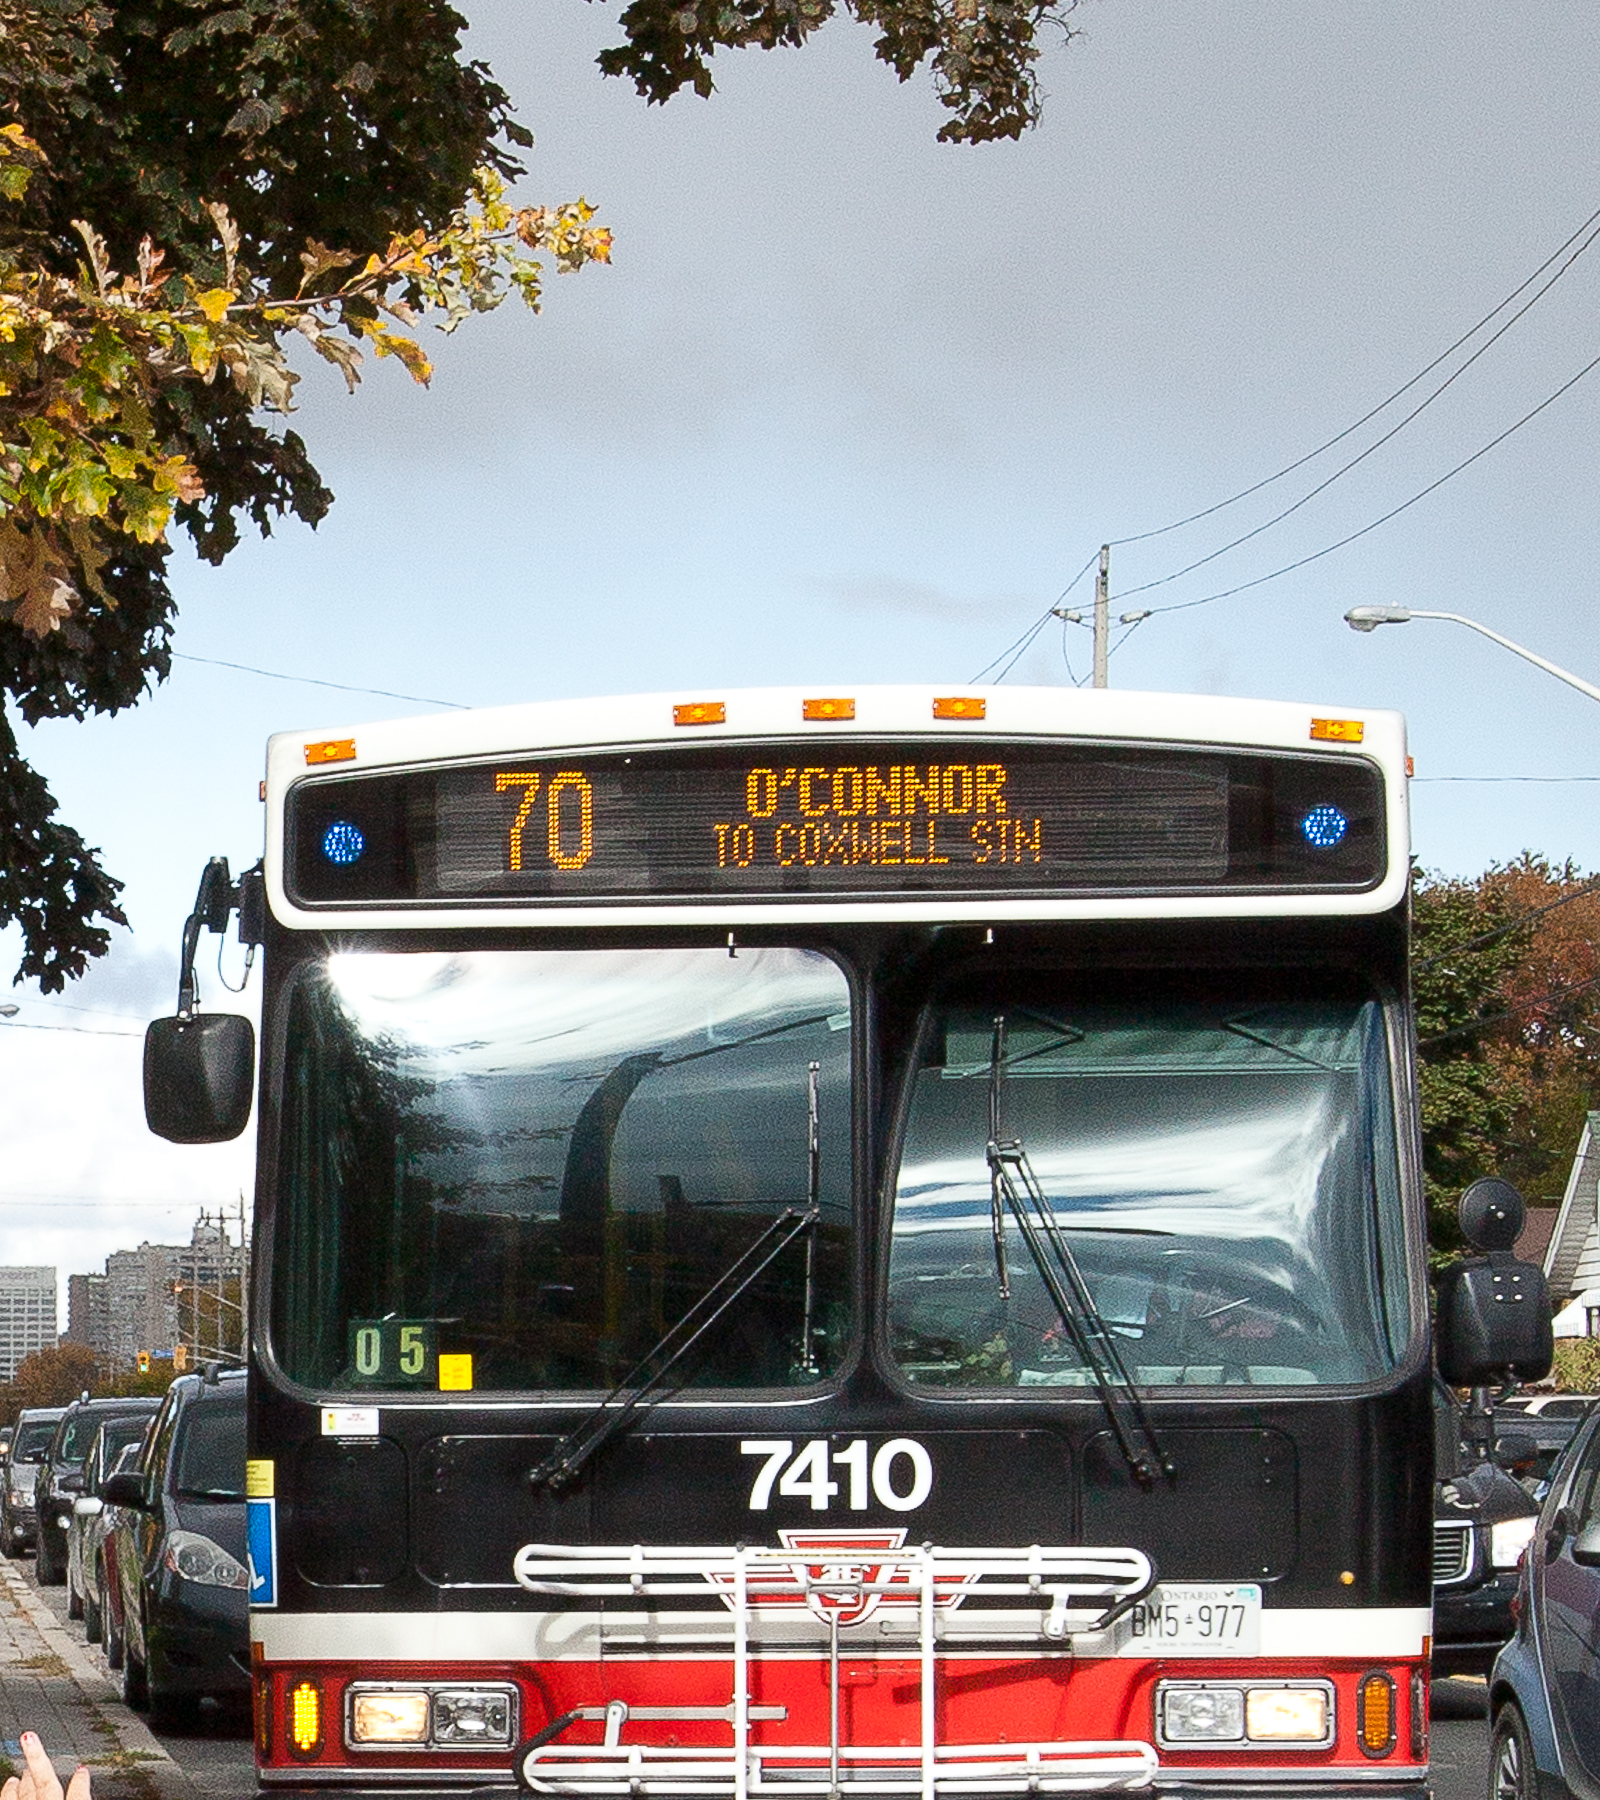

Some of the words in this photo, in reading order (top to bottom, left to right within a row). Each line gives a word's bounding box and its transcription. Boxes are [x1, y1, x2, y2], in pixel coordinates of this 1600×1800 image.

[495, 770, 593, 871] 70
[746, 764, 1007, 818] O'CONNOR
[714, 822, 754, 868] TO
[774, 820, 949, 867] COXWELL
[970, 818, 1042, 864] STN
[740, 1438, 933, 1511] 7410
